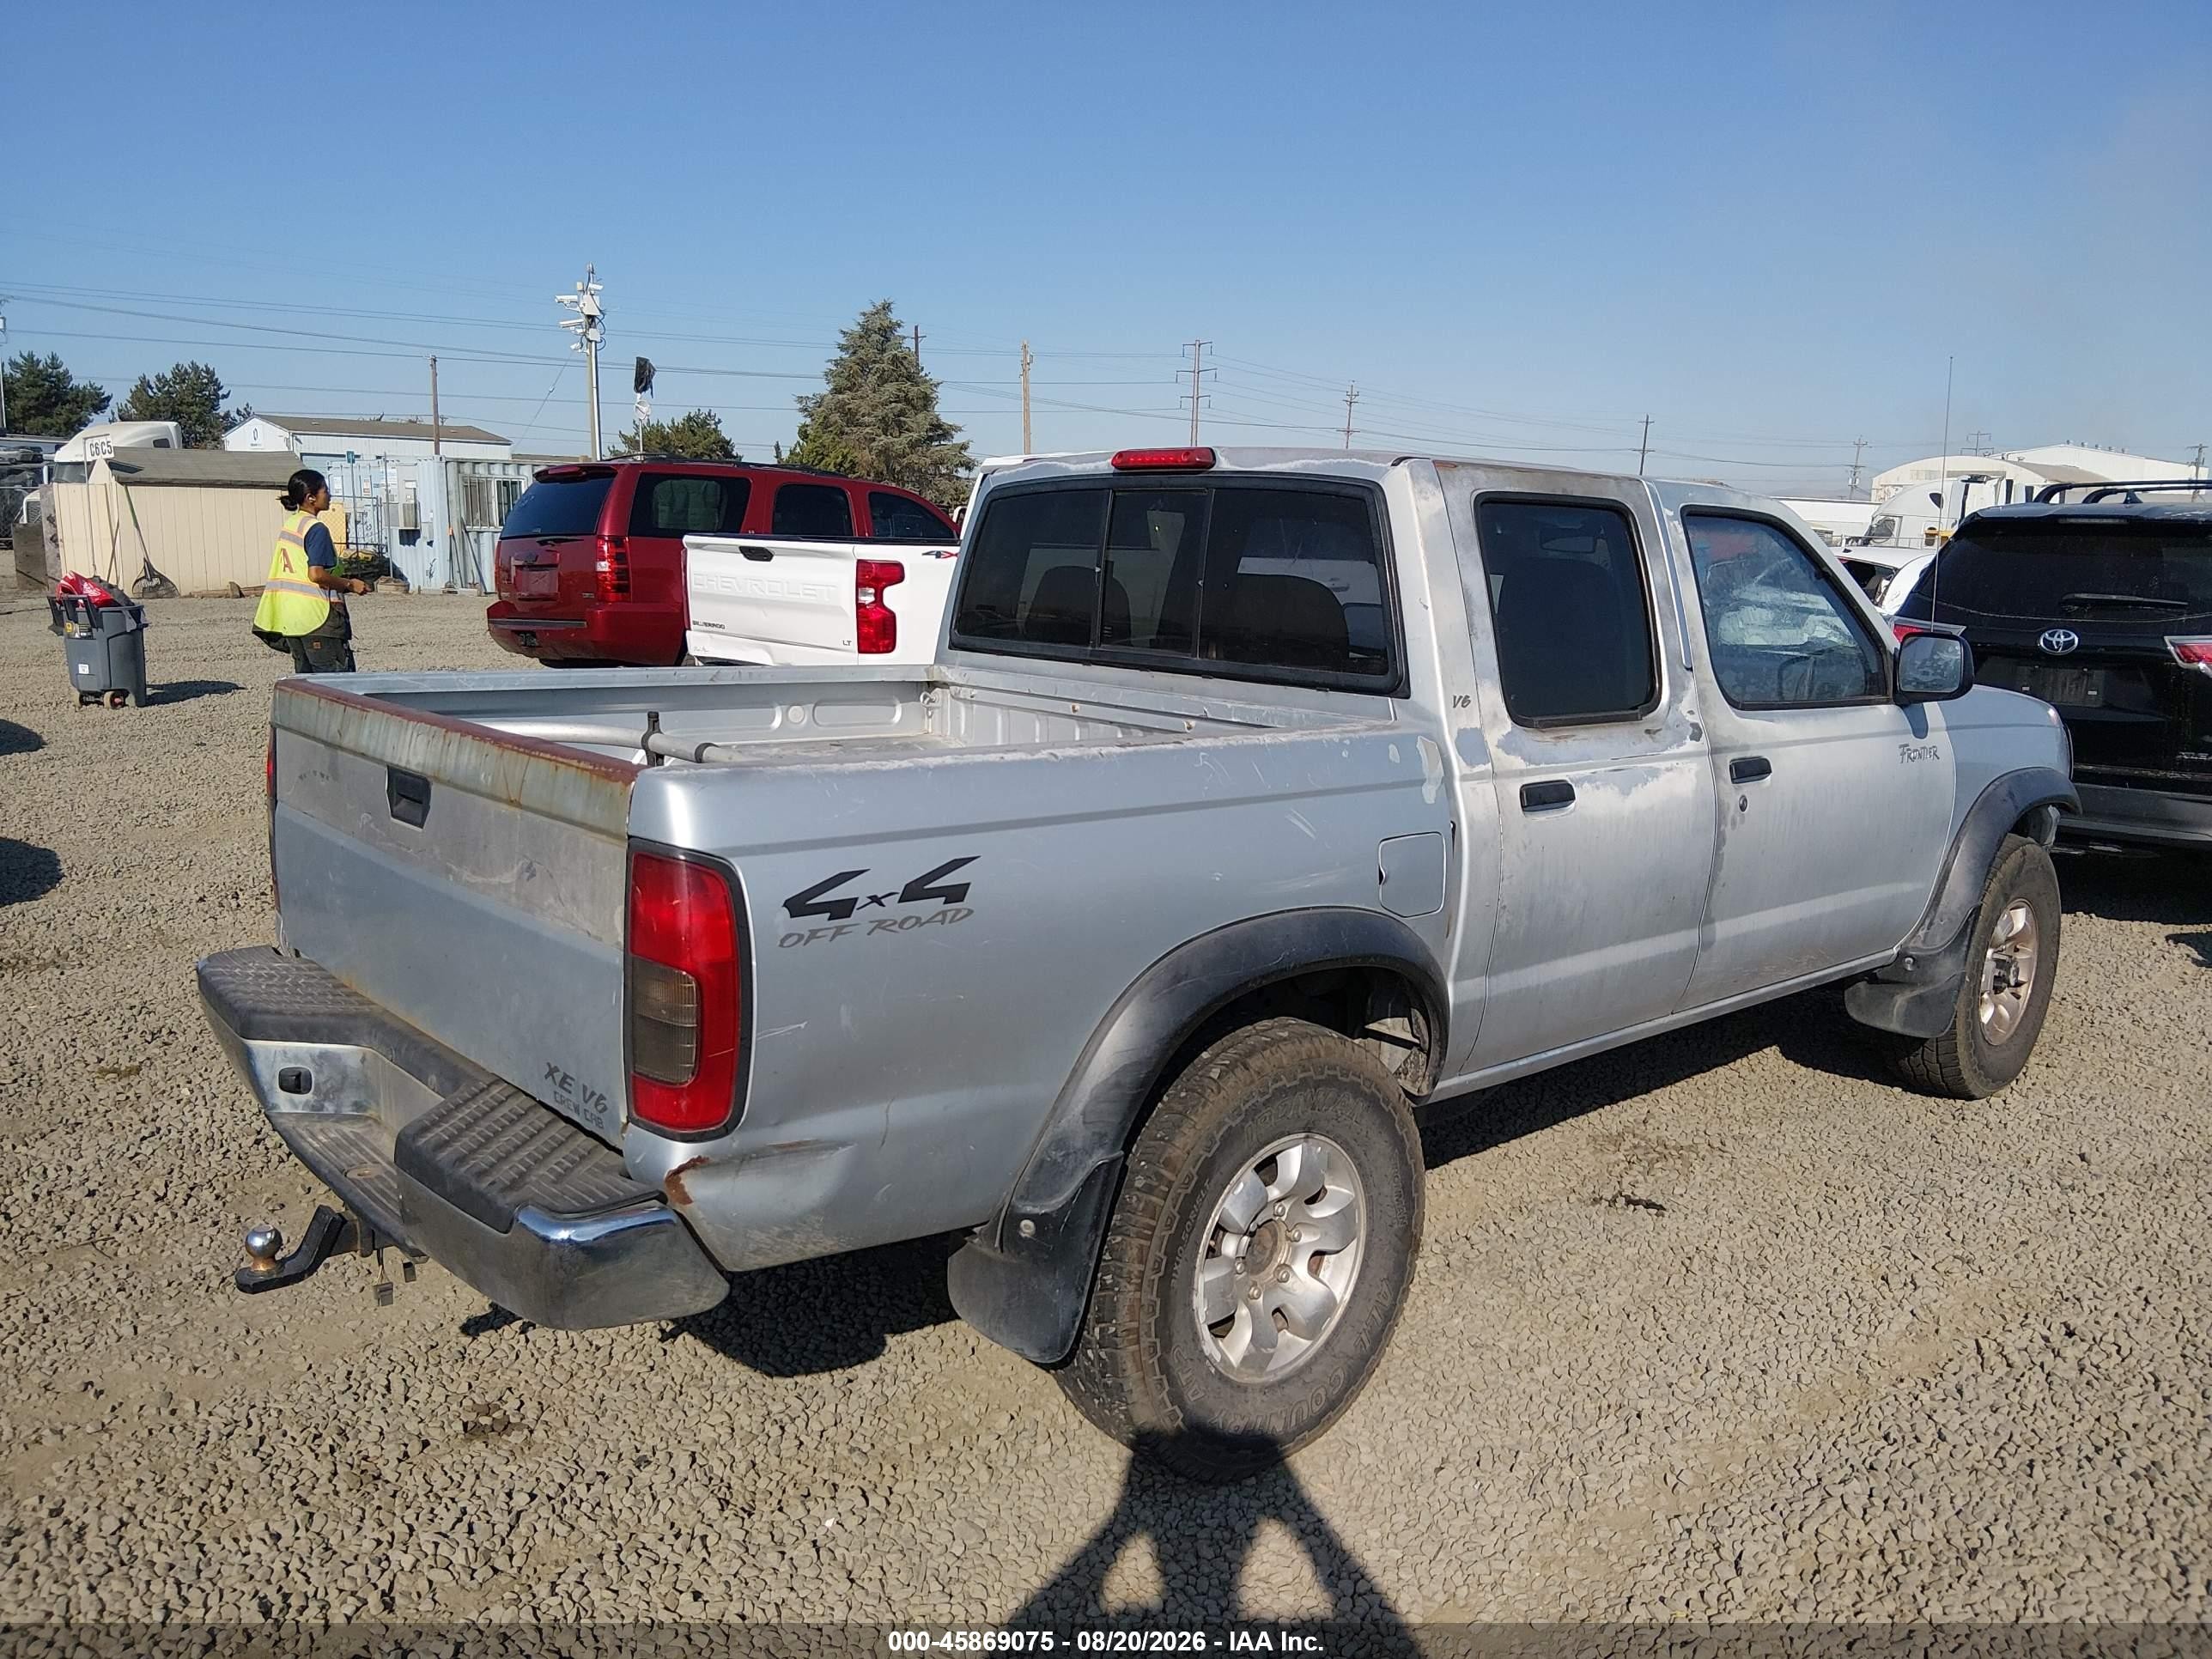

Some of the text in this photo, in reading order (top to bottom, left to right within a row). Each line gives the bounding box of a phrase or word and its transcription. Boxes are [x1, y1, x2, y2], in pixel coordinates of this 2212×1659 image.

[100, 440, 112, 455] C5
[692, 573, 839, 600] CHEVROLET
[1452, 694, 1472, 708] V6
[778, 908, 975, 948] OFF ROAD
[544, 1061, 609, 1114] XE V6
[553, 1091, 605, 1129] CREW CAB
